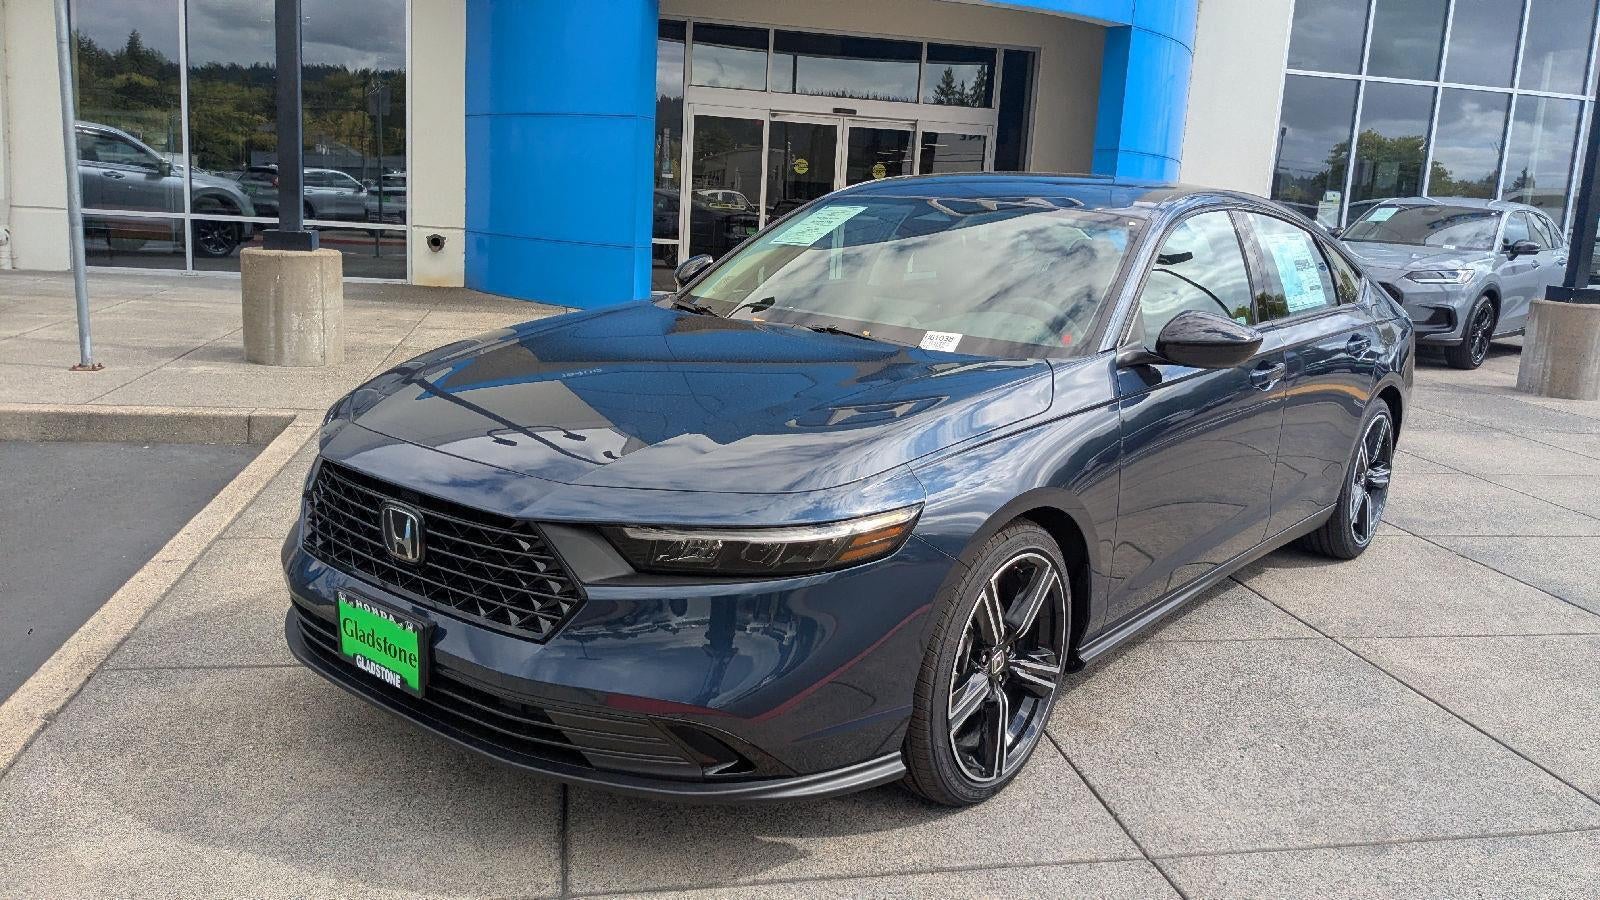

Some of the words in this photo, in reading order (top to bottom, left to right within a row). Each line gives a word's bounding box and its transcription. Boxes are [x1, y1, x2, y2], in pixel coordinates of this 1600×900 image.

[355, 599, 396, 624] HONDA
[343, 618, 418, 668] Gladstone
[356, 654, 401, 689] GLADSTONE
